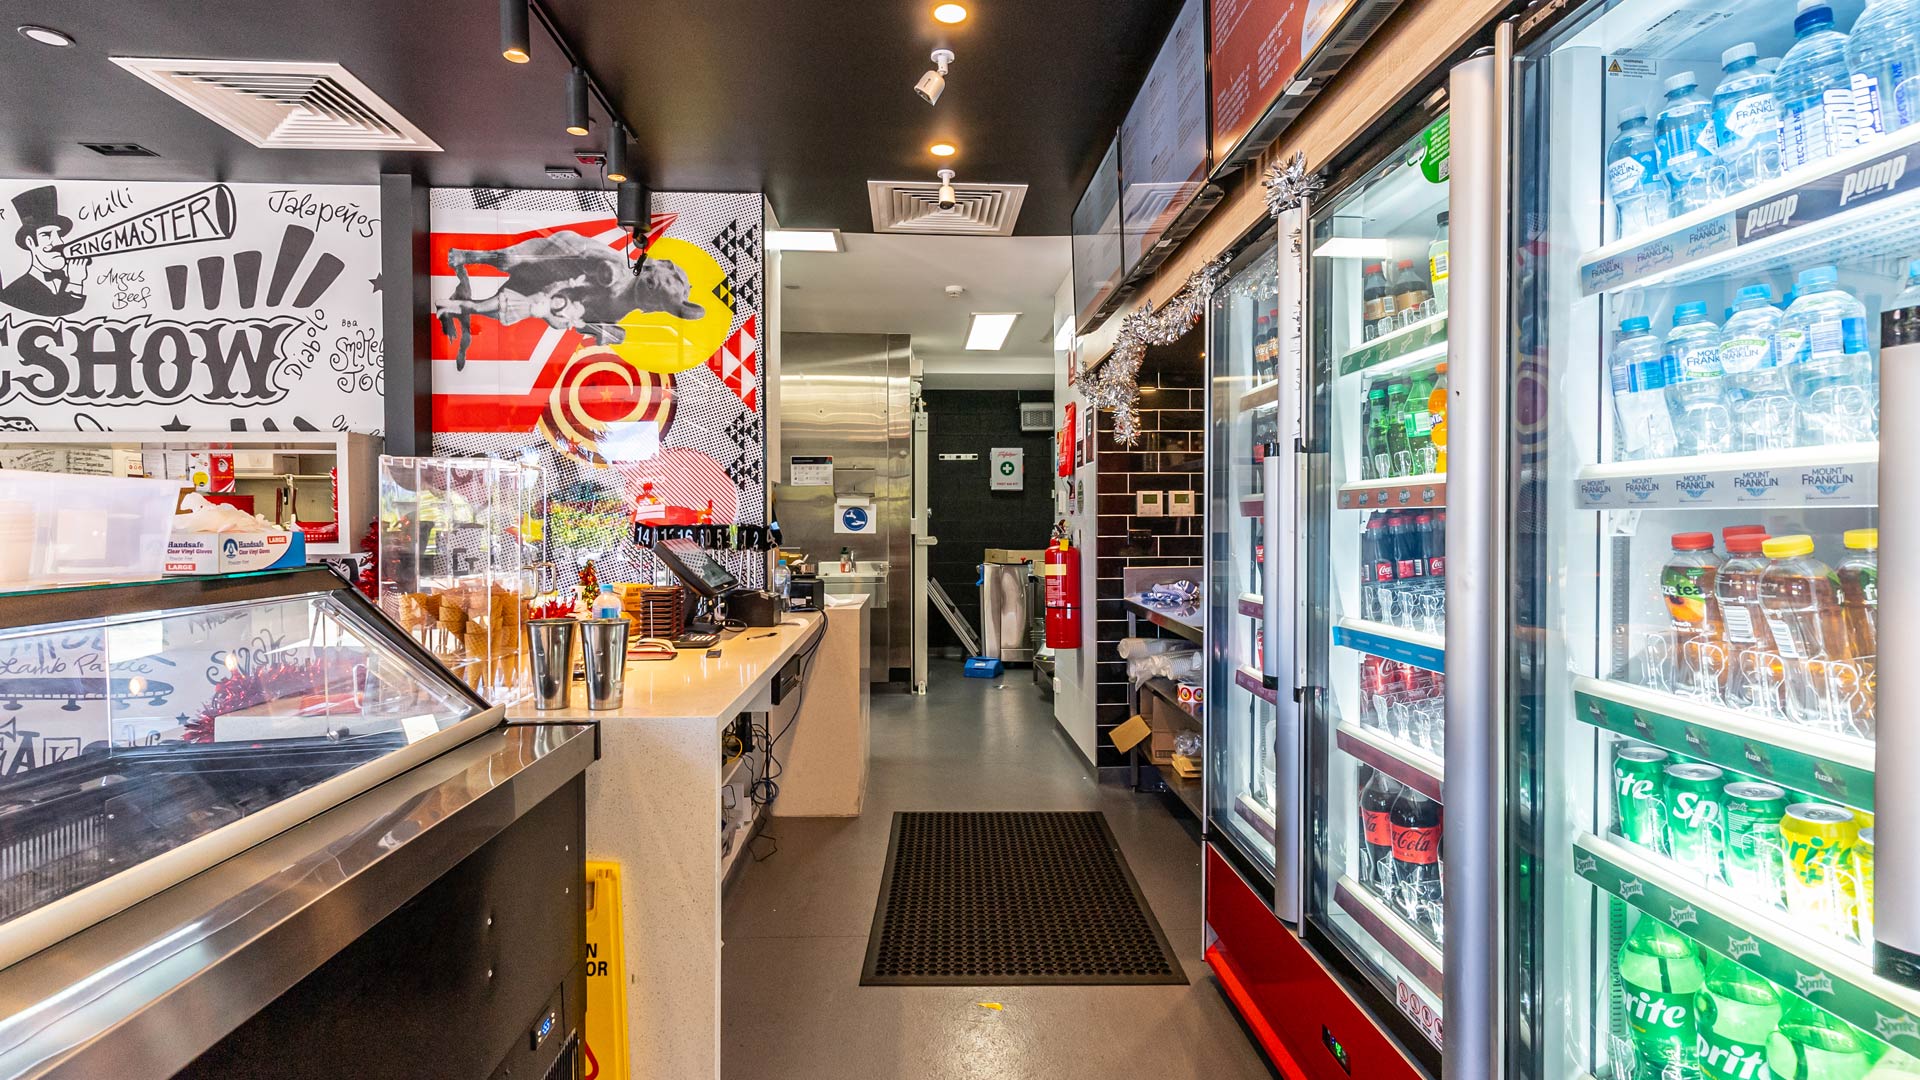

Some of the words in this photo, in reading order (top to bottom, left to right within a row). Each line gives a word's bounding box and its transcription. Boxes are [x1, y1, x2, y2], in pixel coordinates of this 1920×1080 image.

[1840, 155, 1907, 207] pump
[1744, 193, 1799, 239] pump
[69, 196, 219, 258] RINGMASTER
[1689, 224, 1726, 244] FRANKLIN
[96, 268, 145, 291] Angus
[112, 287, 152, 310] Beef
[284, 309, 328, 380] Diabolo
[1812, 467, 1844, 475] MOUNT
[1676, 480, 1714, 490] FRANKLIN
[1734, 477, 1779, 488] FRANKLIN
[1802, 474, 1853, 485] FRANKLIN
[1581, 485, 1611, 493] FRANKLIN
[1626, 482, 1659, 492] FRANKLIN
[637, 526, 650, 541] 14
[753, 530, 759, 543] 2
[1621, 883, 1641, 894] Sprite
[1672, 910, 1695, 922] Sprite
[1731, 940, 1757, 954] Sprite
[1800, 975, 1829, 990] Sprite
[1880, 1019, 1914, 1036] Sprite
